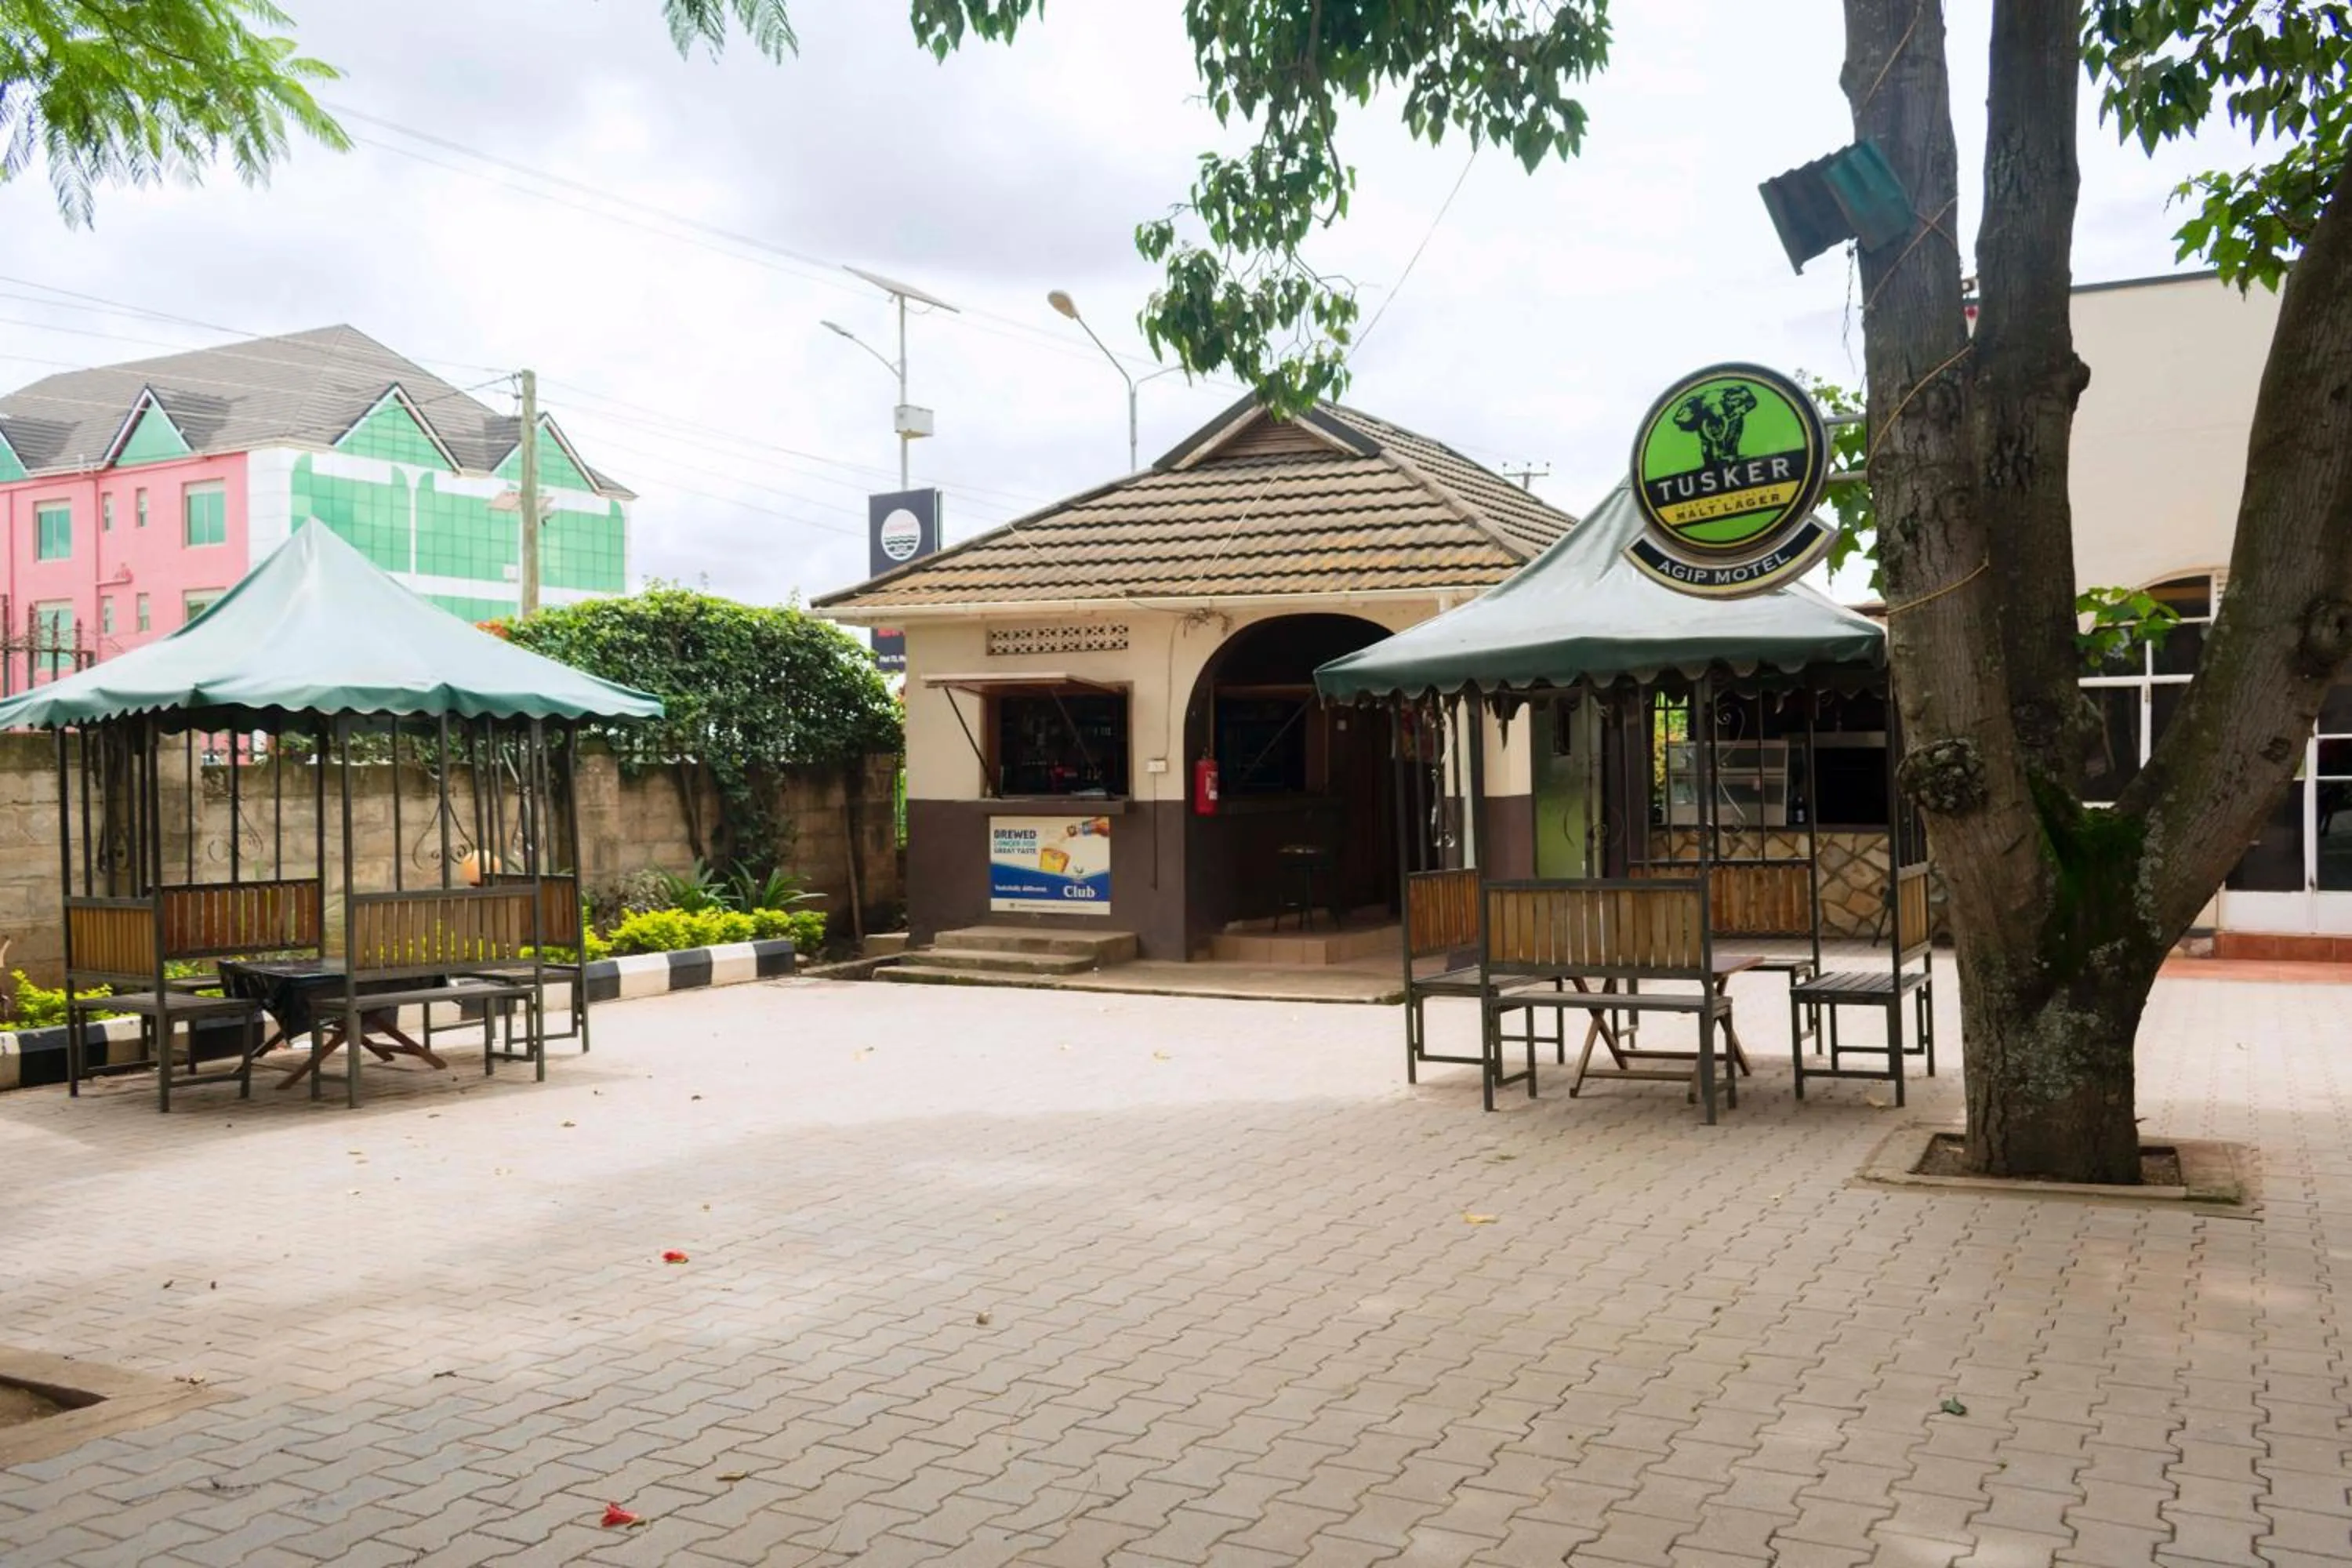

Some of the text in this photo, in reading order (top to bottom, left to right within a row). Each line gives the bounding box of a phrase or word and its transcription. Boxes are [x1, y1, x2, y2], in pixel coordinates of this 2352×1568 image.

[1657, 457, 1791, 502] TUSKER
[1675, 506, 1715, 521] MALT
[1724, 493, 1780, 511] LAGER
[1657, 553, 1791, 583] AGIP MOTEL
[994, 829, 1036, 839] BREWED
[1063, 885, 1095, 898] Club
